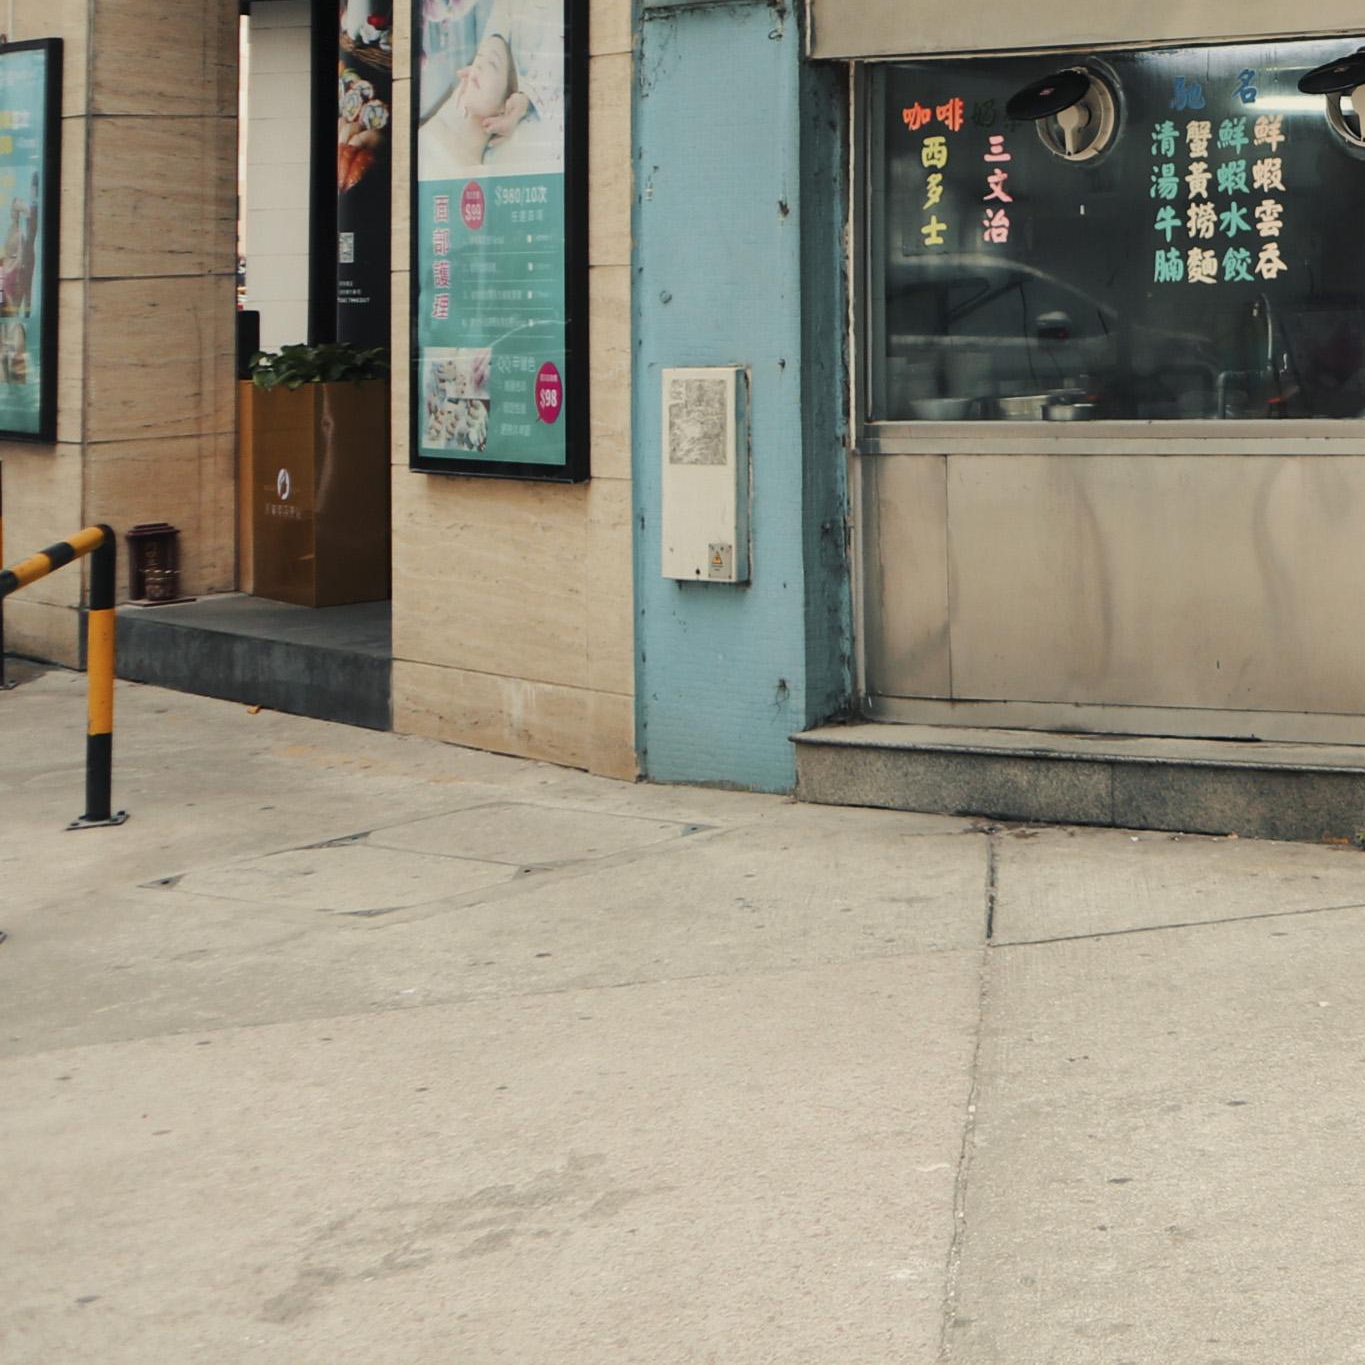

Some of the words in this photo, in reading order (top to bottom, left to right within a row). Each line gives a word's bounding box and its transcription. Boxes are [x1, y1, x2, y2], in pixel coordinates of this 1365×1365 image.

[921, 136, 949, 246] 西多士
[983, 135, 1014, 243] 三文治
[1150, 120, 1185, 283] 清湯牛腩
[1217, 116, 1255, 281] 鮮蝦水餃
[1252, 113, 1288, 280] 鮮蝦雲吞
[432, 194, 450, 320] 面部護理
[540, 389, 558, 411] $98
